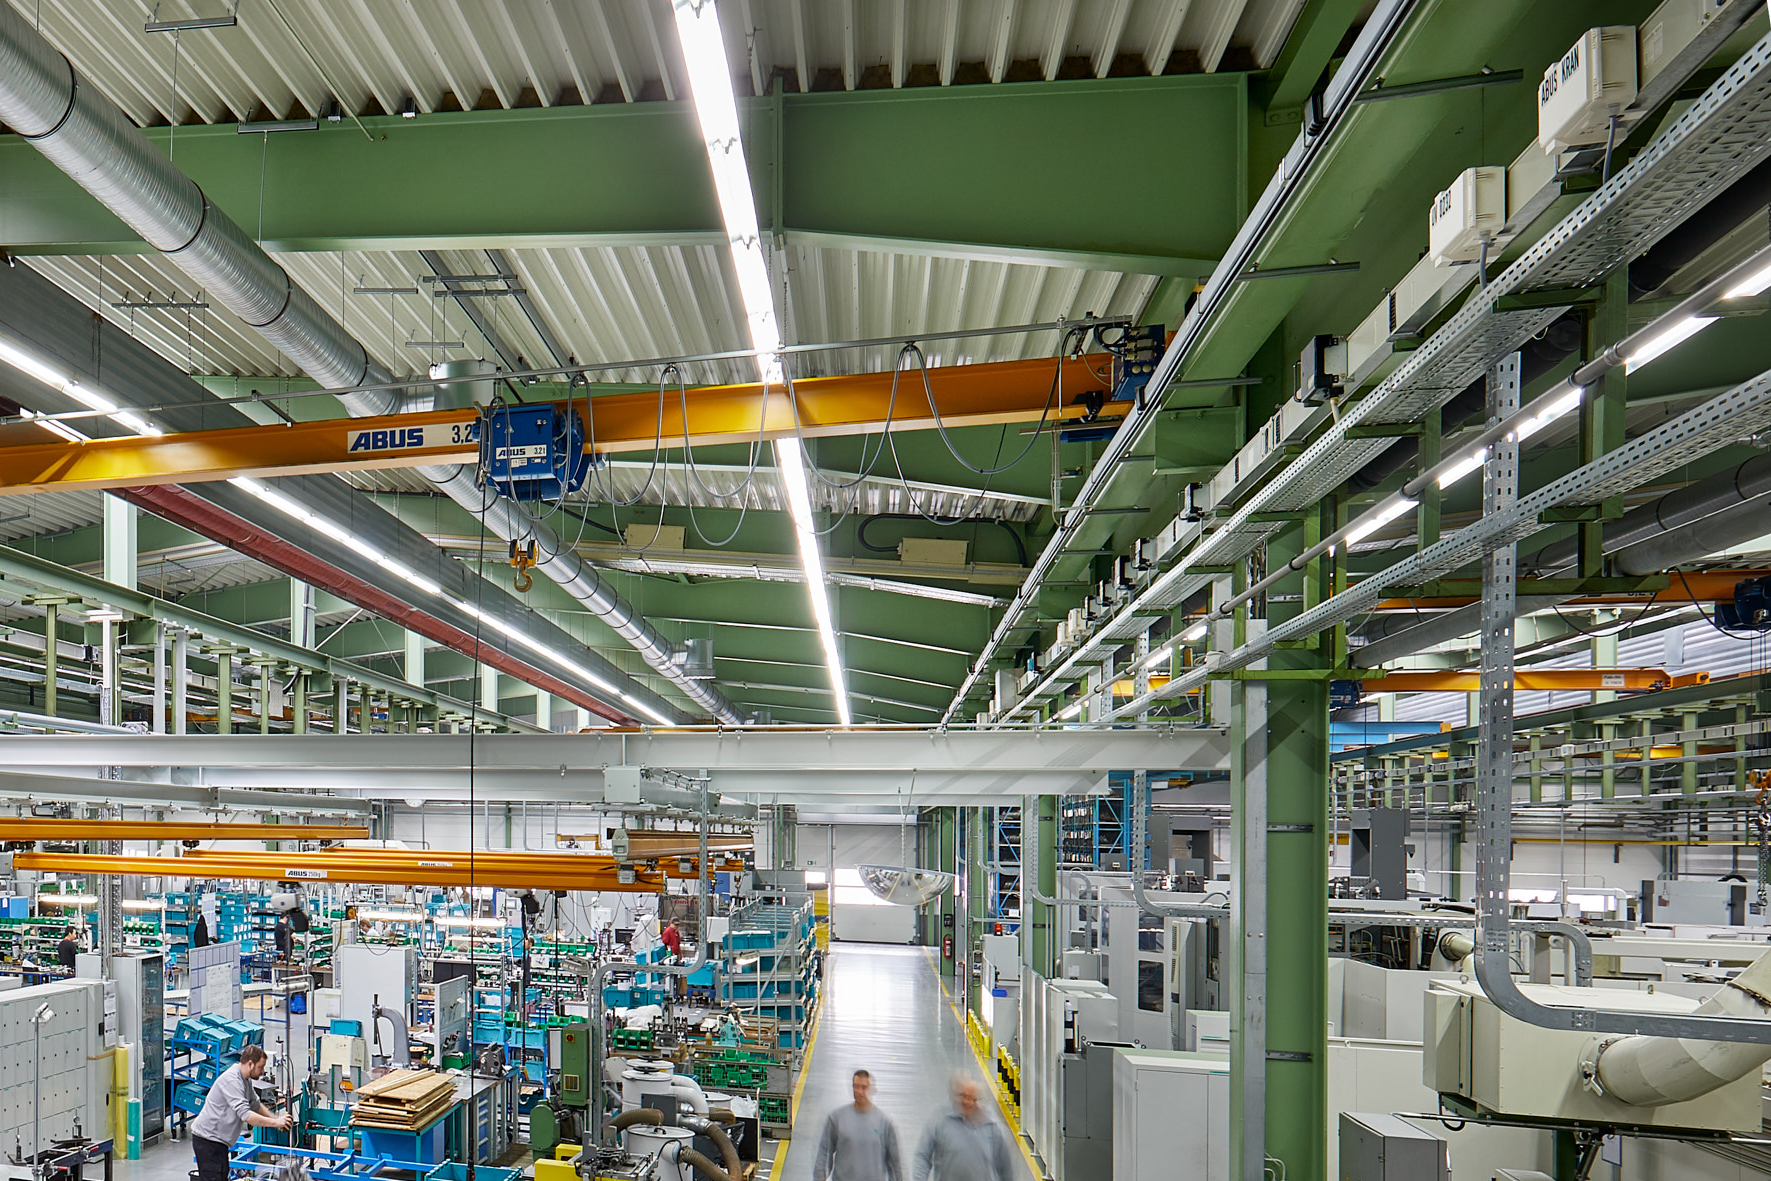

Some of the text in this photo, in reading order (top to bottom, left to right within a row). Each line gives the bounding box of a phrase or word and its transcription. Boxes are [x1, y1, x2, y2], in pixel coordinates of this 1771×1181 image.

[1541, 44, 1579, 107] ABUS KRAN
[350, 427, 424, 451] ABUS
[498, 448, 526, 456] AUS
